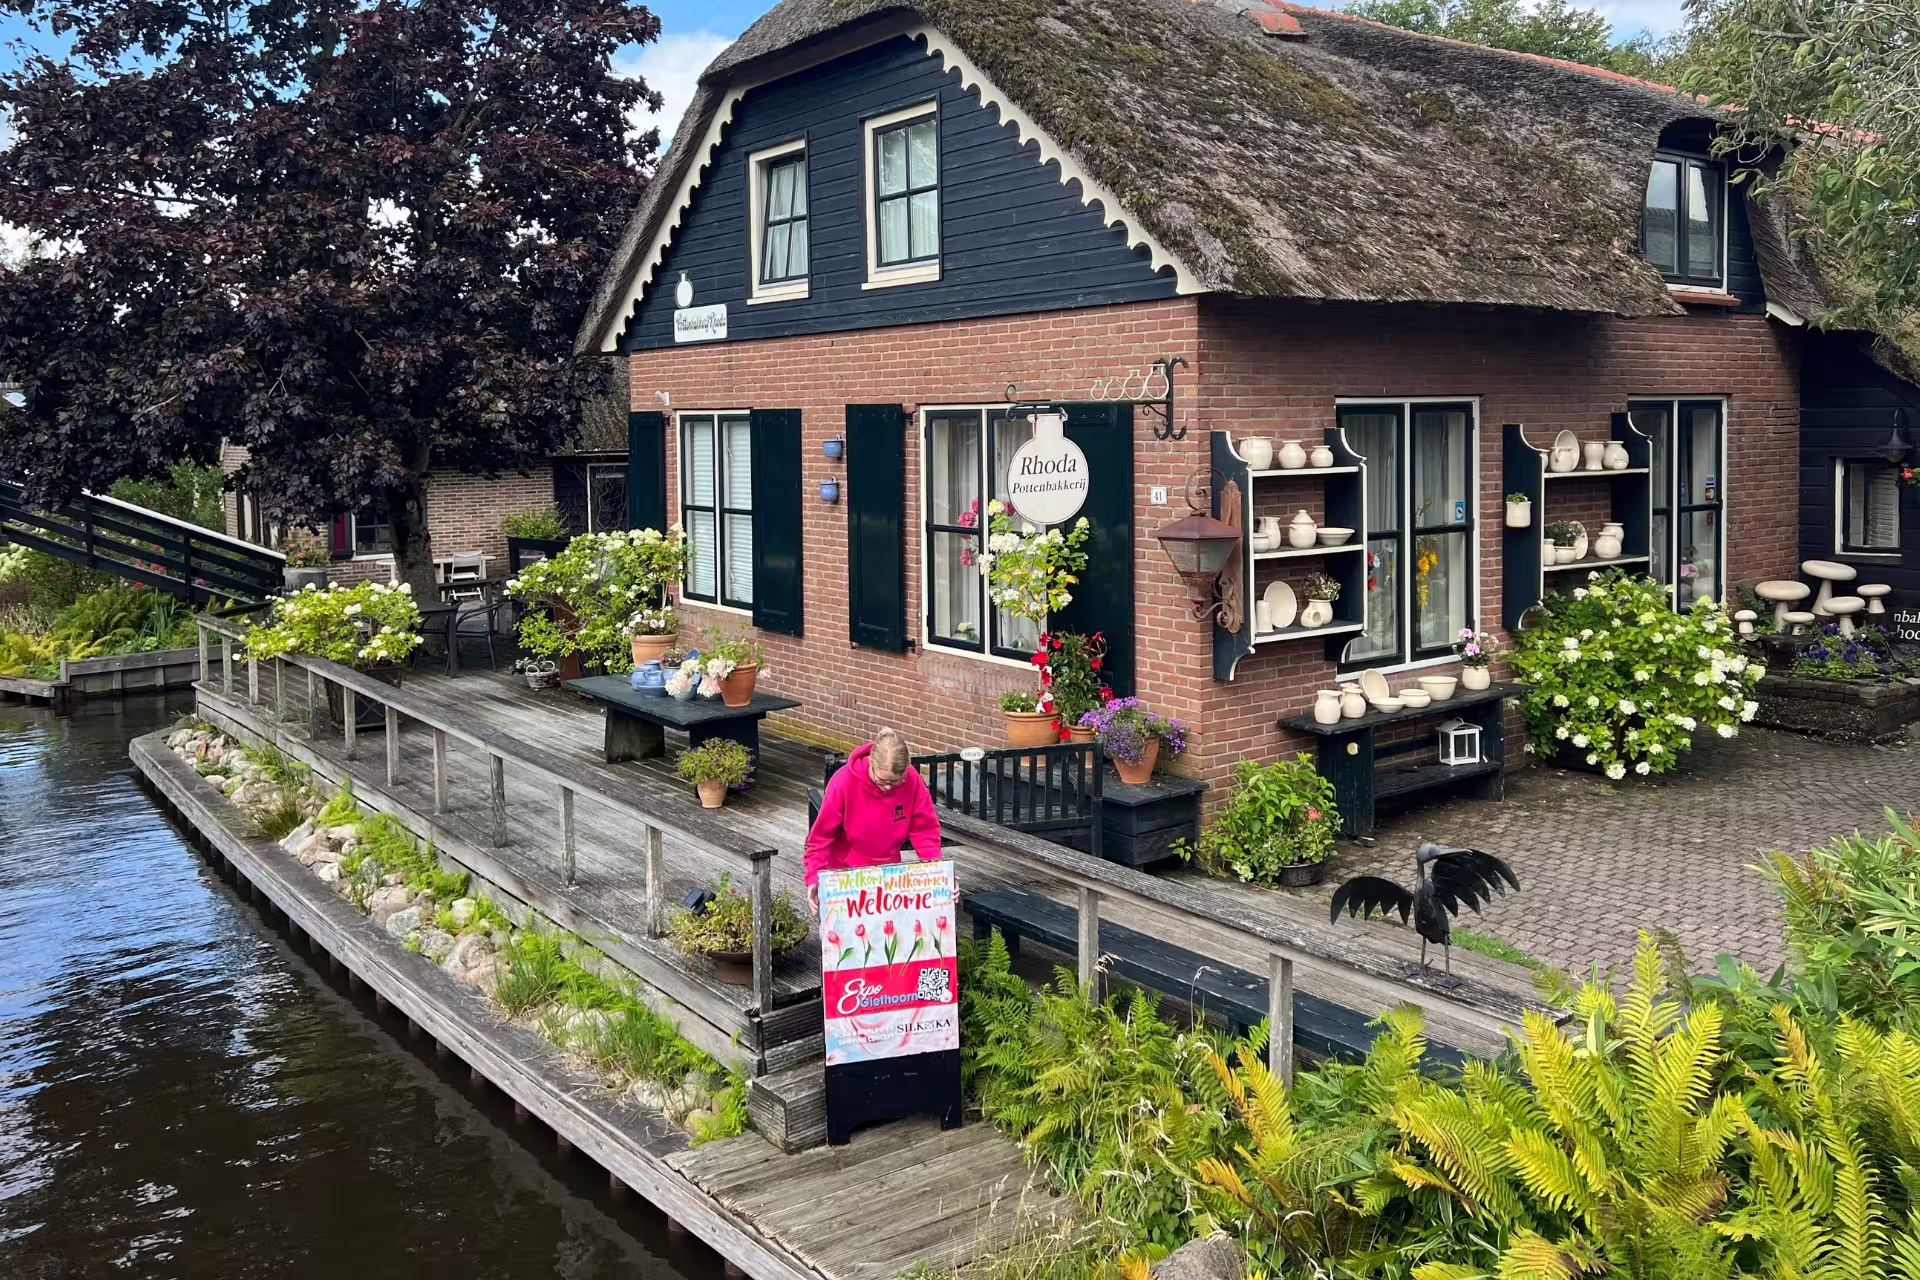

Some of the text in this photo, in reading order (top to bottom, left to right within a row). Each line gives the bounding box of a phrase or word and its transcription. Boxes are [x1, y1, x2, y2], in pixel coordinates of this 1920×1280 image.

[1020, 453, 1077, 476] Rhoda
[1012, 478, 1087, 494] Pottenbakkerij
[1153, 490, 1163, 502] 41
[1893, 610, 1920, 624] nba
[839, 870, 882, 889] Welkom
[884, 872, 948, 891] Willkommen
[846, 886, 932, 918] Welcome
[837, 978, 883, 1014] Expo
[860, 992, 919, 1009] Giethoorn
